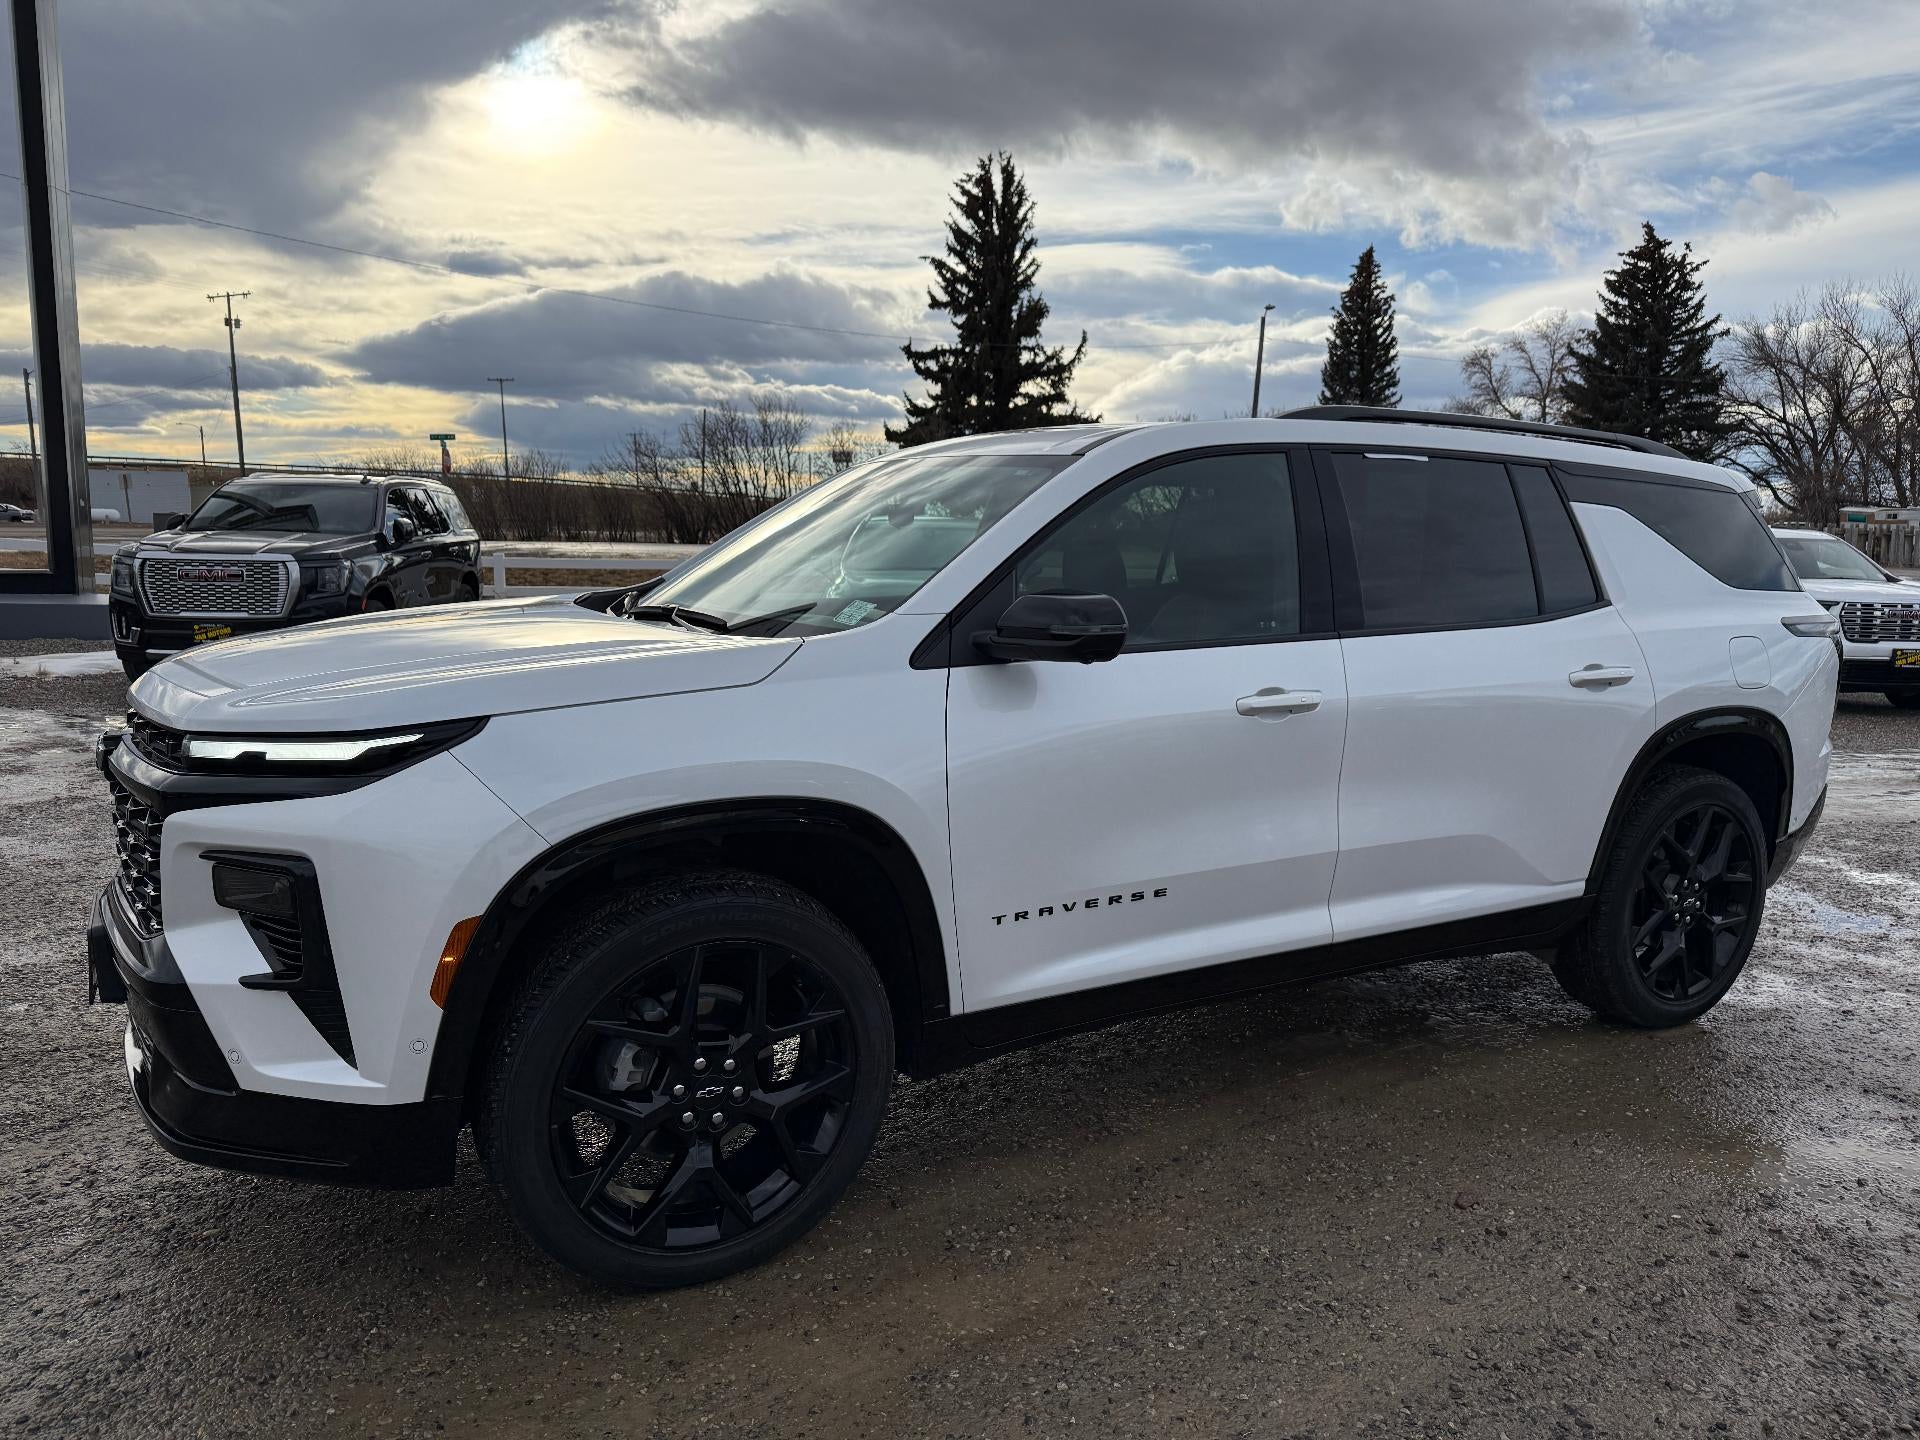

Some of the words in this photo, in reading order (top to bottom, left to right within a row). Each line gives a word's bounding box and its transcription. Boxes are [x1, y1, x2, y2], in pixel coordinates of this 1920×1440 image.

[179, 569, 242, 582] GMC
[1889, 610, 1920, 620] GM
[207, 626, 232, 638] MOTORS
[991, 887, 1168, 926] TRAVERSE
